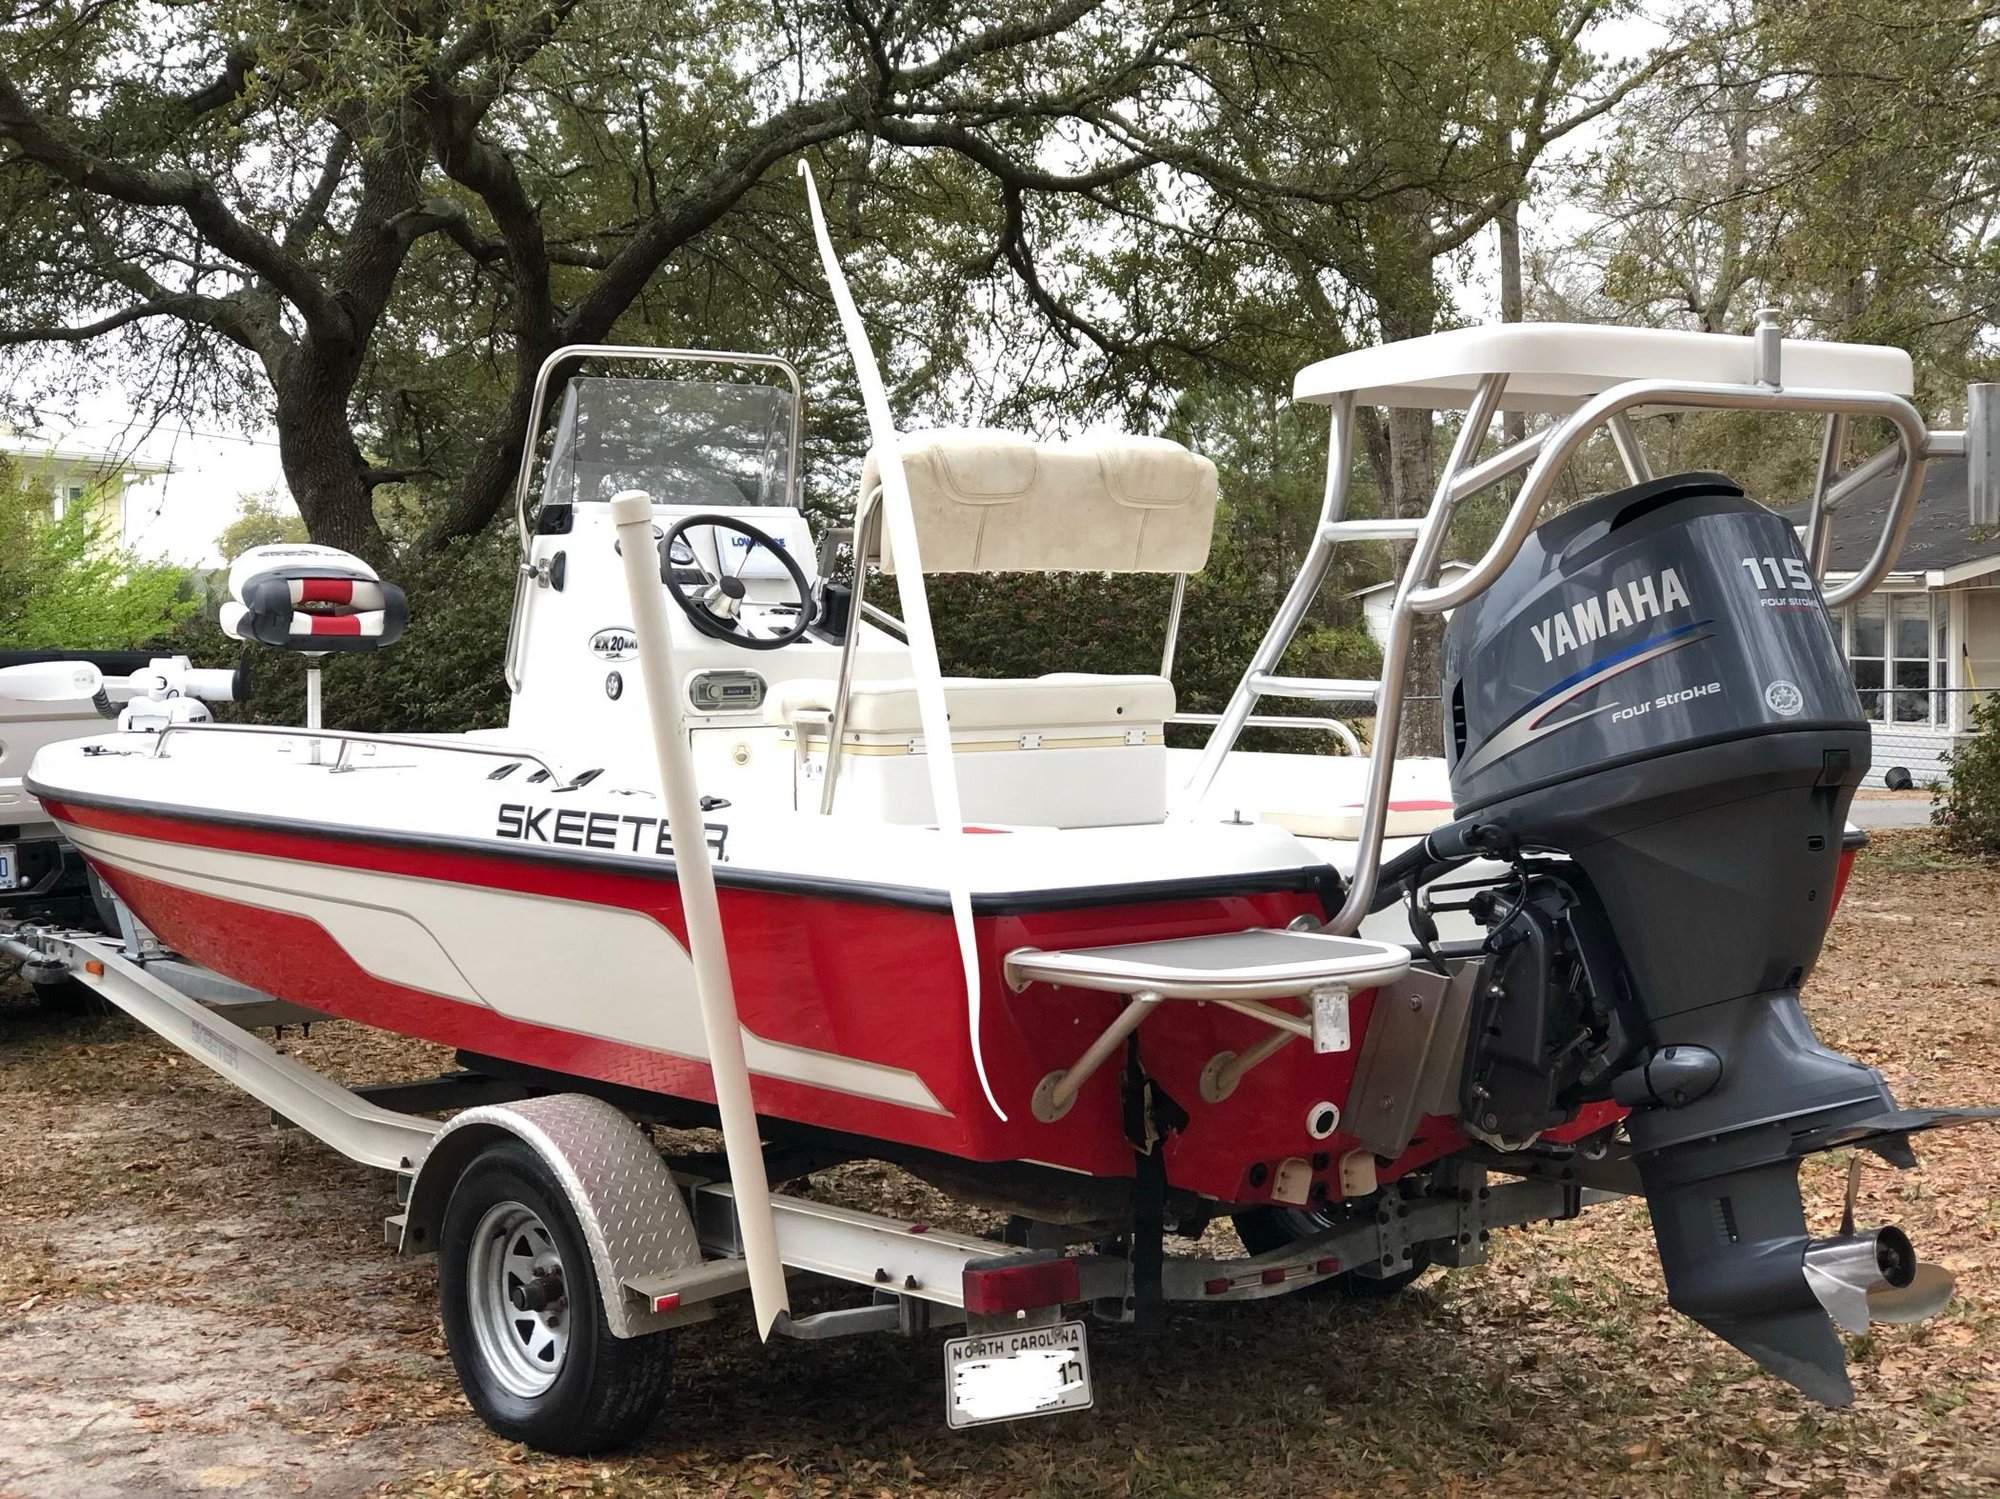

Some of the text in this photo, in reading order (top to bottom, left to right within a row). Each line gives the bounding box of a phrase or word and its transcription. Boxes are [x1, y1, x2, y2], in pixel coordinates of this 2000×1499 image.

[1741, 557, 1813, 590] 115
[1530, 568, 1690, 663] YAMAHA
[953, 1341, 1004, 1360] NORTH
